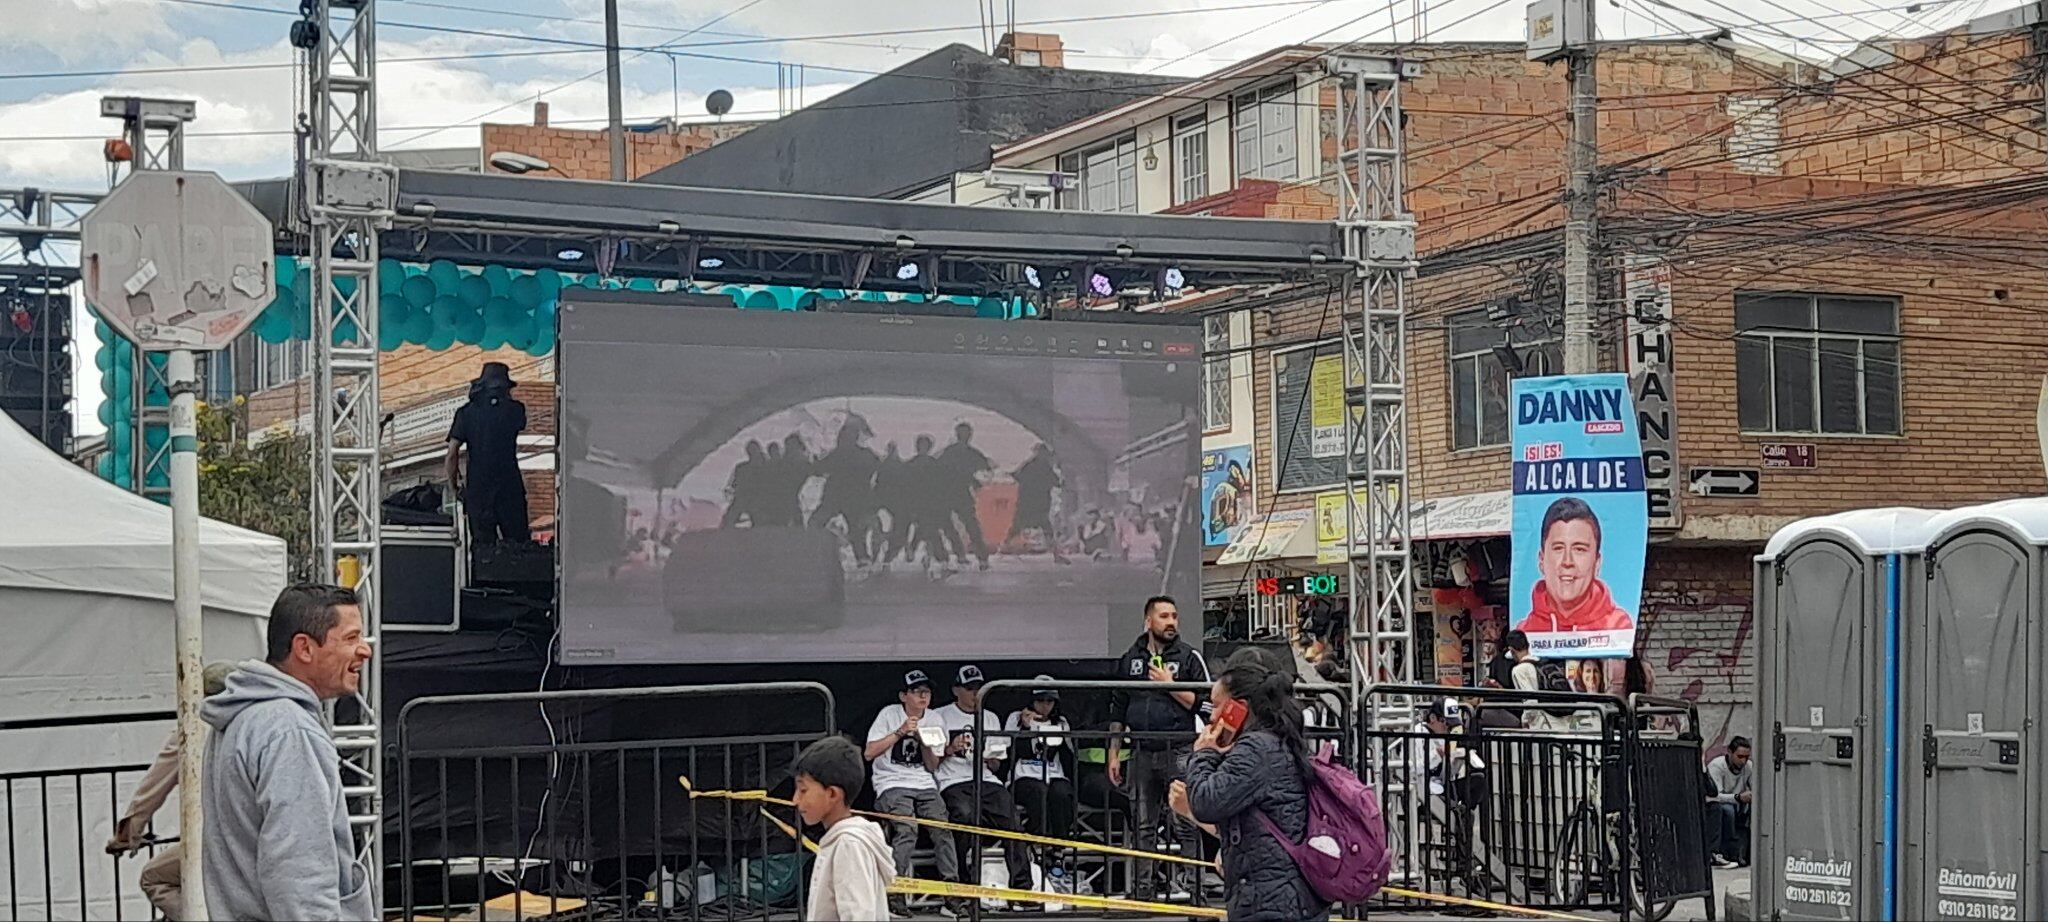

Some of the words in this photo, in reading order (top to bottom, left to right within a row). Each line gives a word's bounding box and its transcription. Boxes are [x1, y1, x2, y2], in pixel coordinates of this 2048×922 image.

[1518, 389, 1622, 425] DANNY
[1635, 298, 1672, 519] CHANCE
[1797, 446, 1808, 456] 18
[1526, 461, 1627, 491] ALCALDE
[1786, 856, 1852, 877] Bañomóvil
[1939, 867, 2017, 890] Bañomóvil
